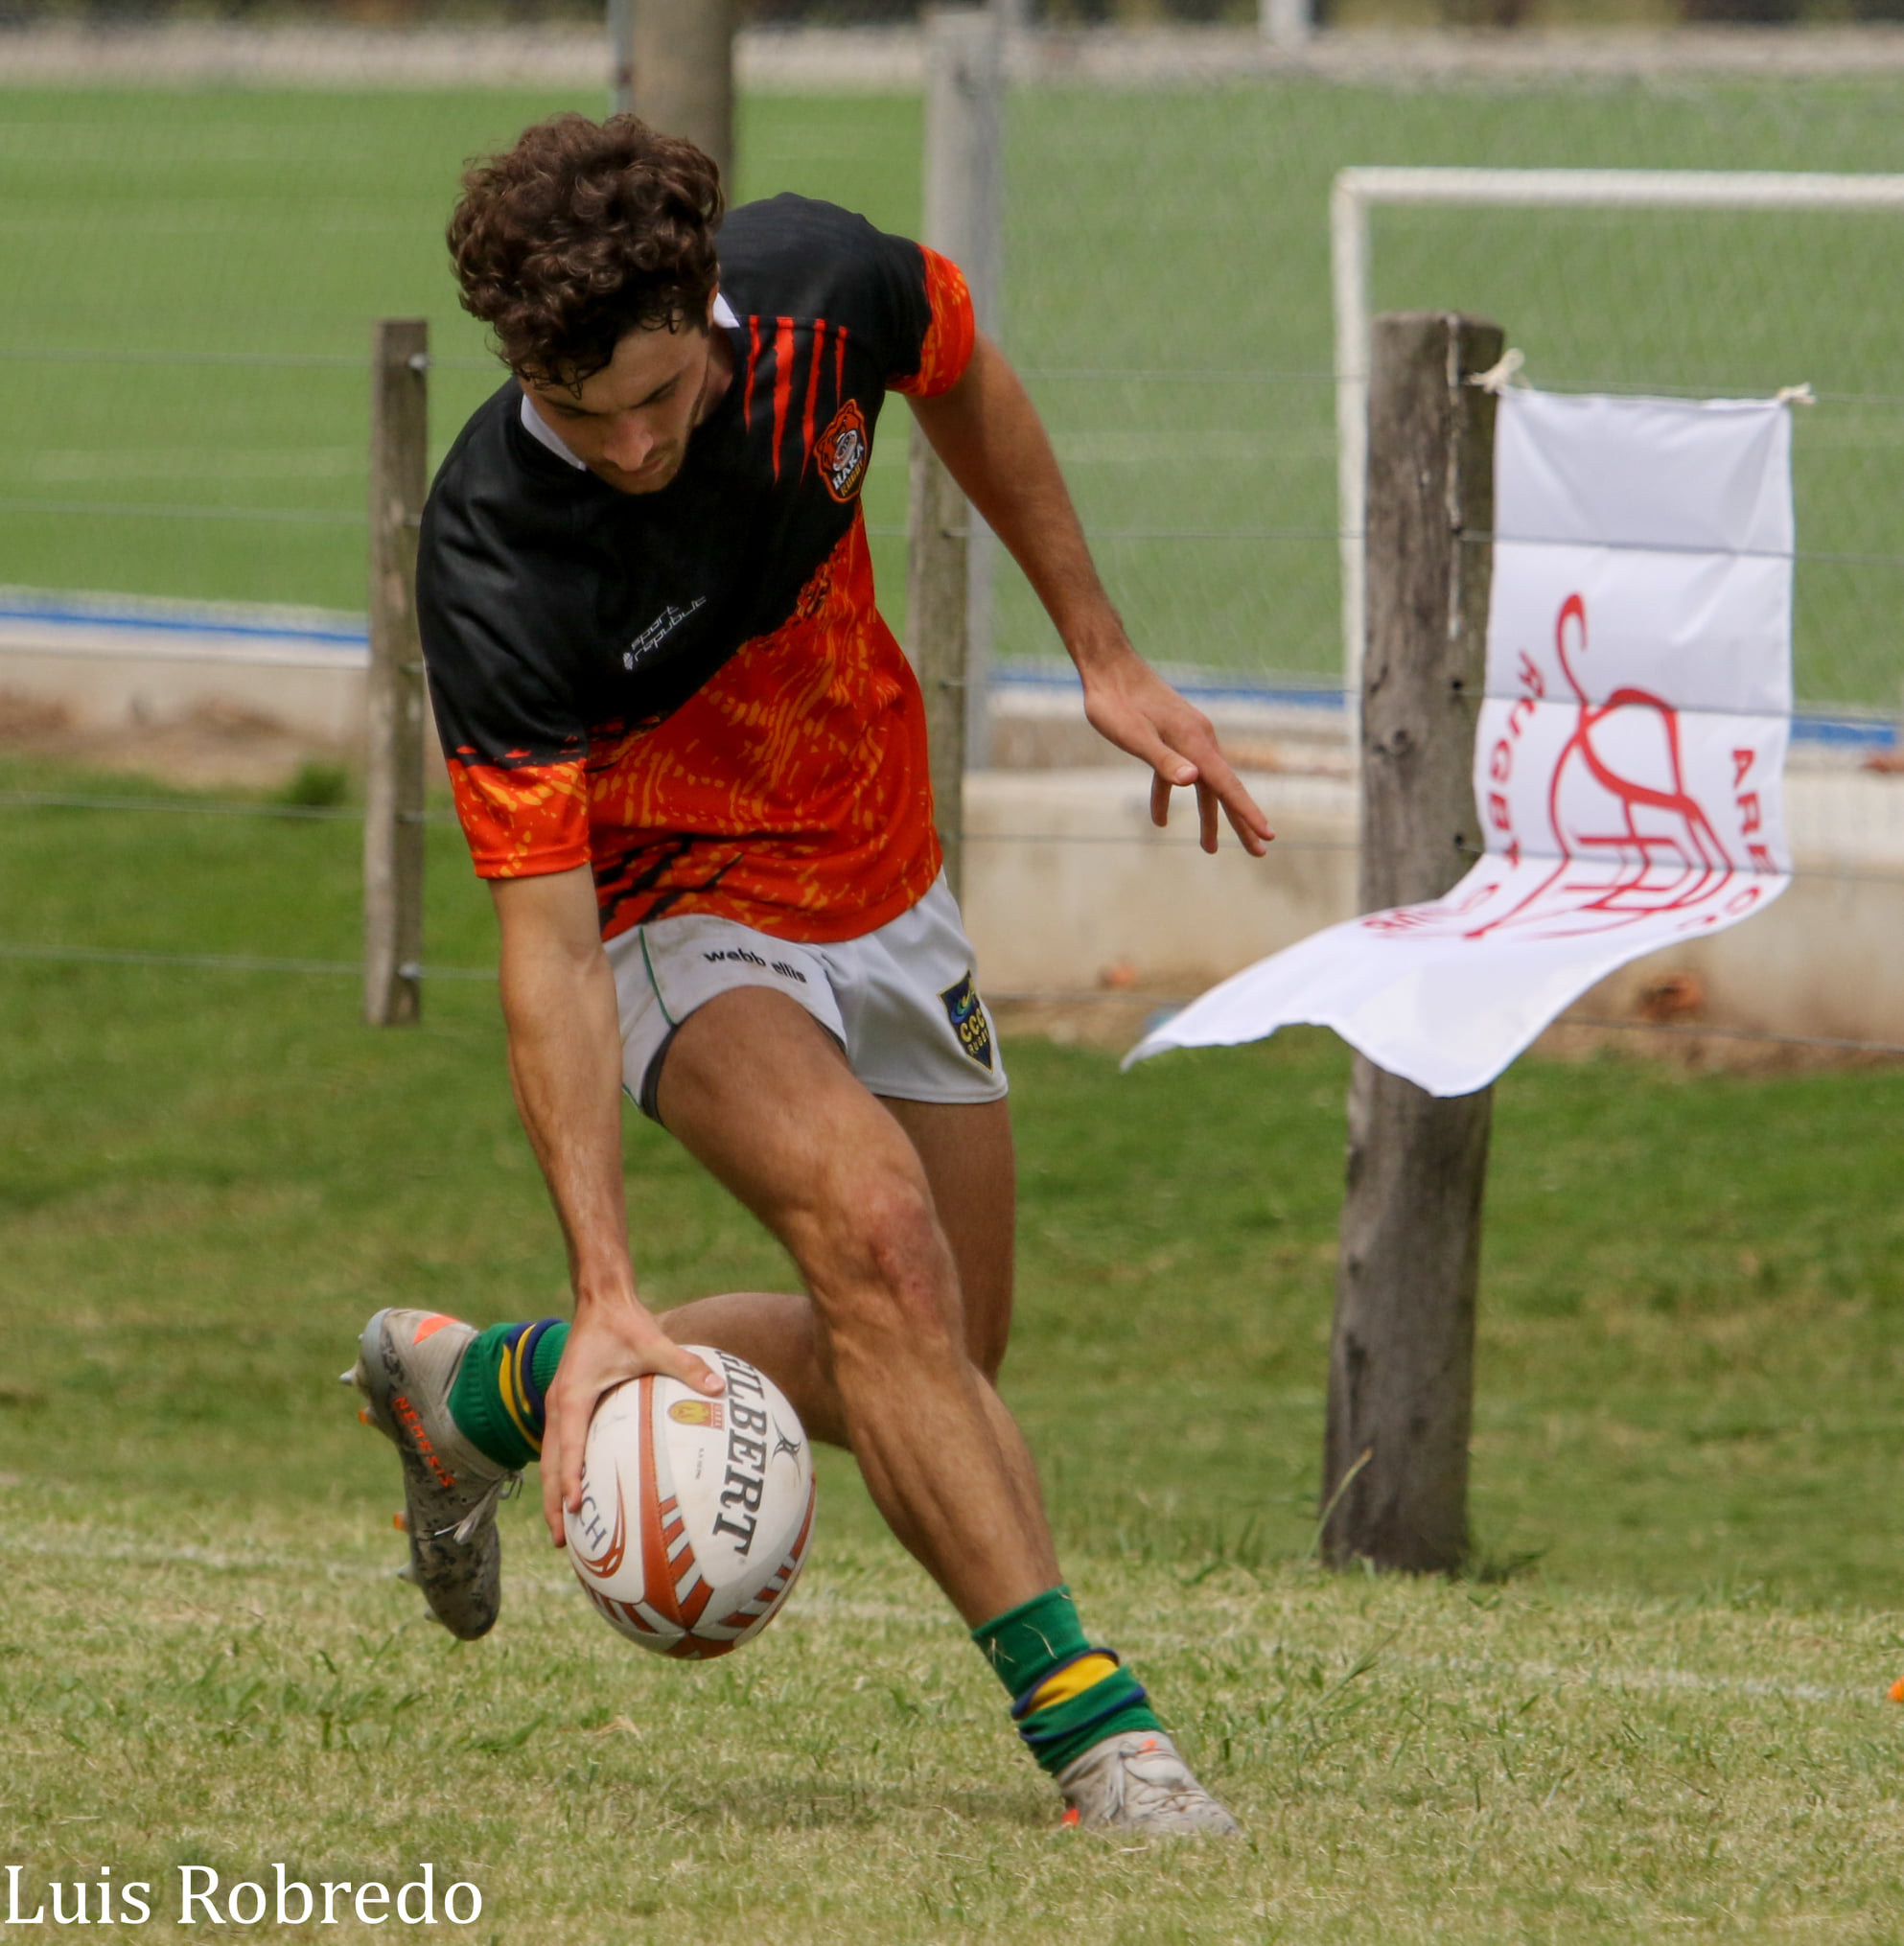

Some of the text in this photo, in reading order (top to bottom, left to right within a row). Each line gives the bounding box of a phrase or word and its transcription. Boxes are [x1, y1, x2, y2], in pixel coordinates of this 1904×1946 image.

[831, 443, 864, 491] HAKA
[631, 605, 680, 651] sport
[634, 595, 708, 662] republic
[1489, 648, 1546, 869] RUGBY
[702, 947, 807, 984] webb ellis
[393, 1396, 456, 1487] NEMESIS
[712, 1349, 768, 1557] GILBERT
